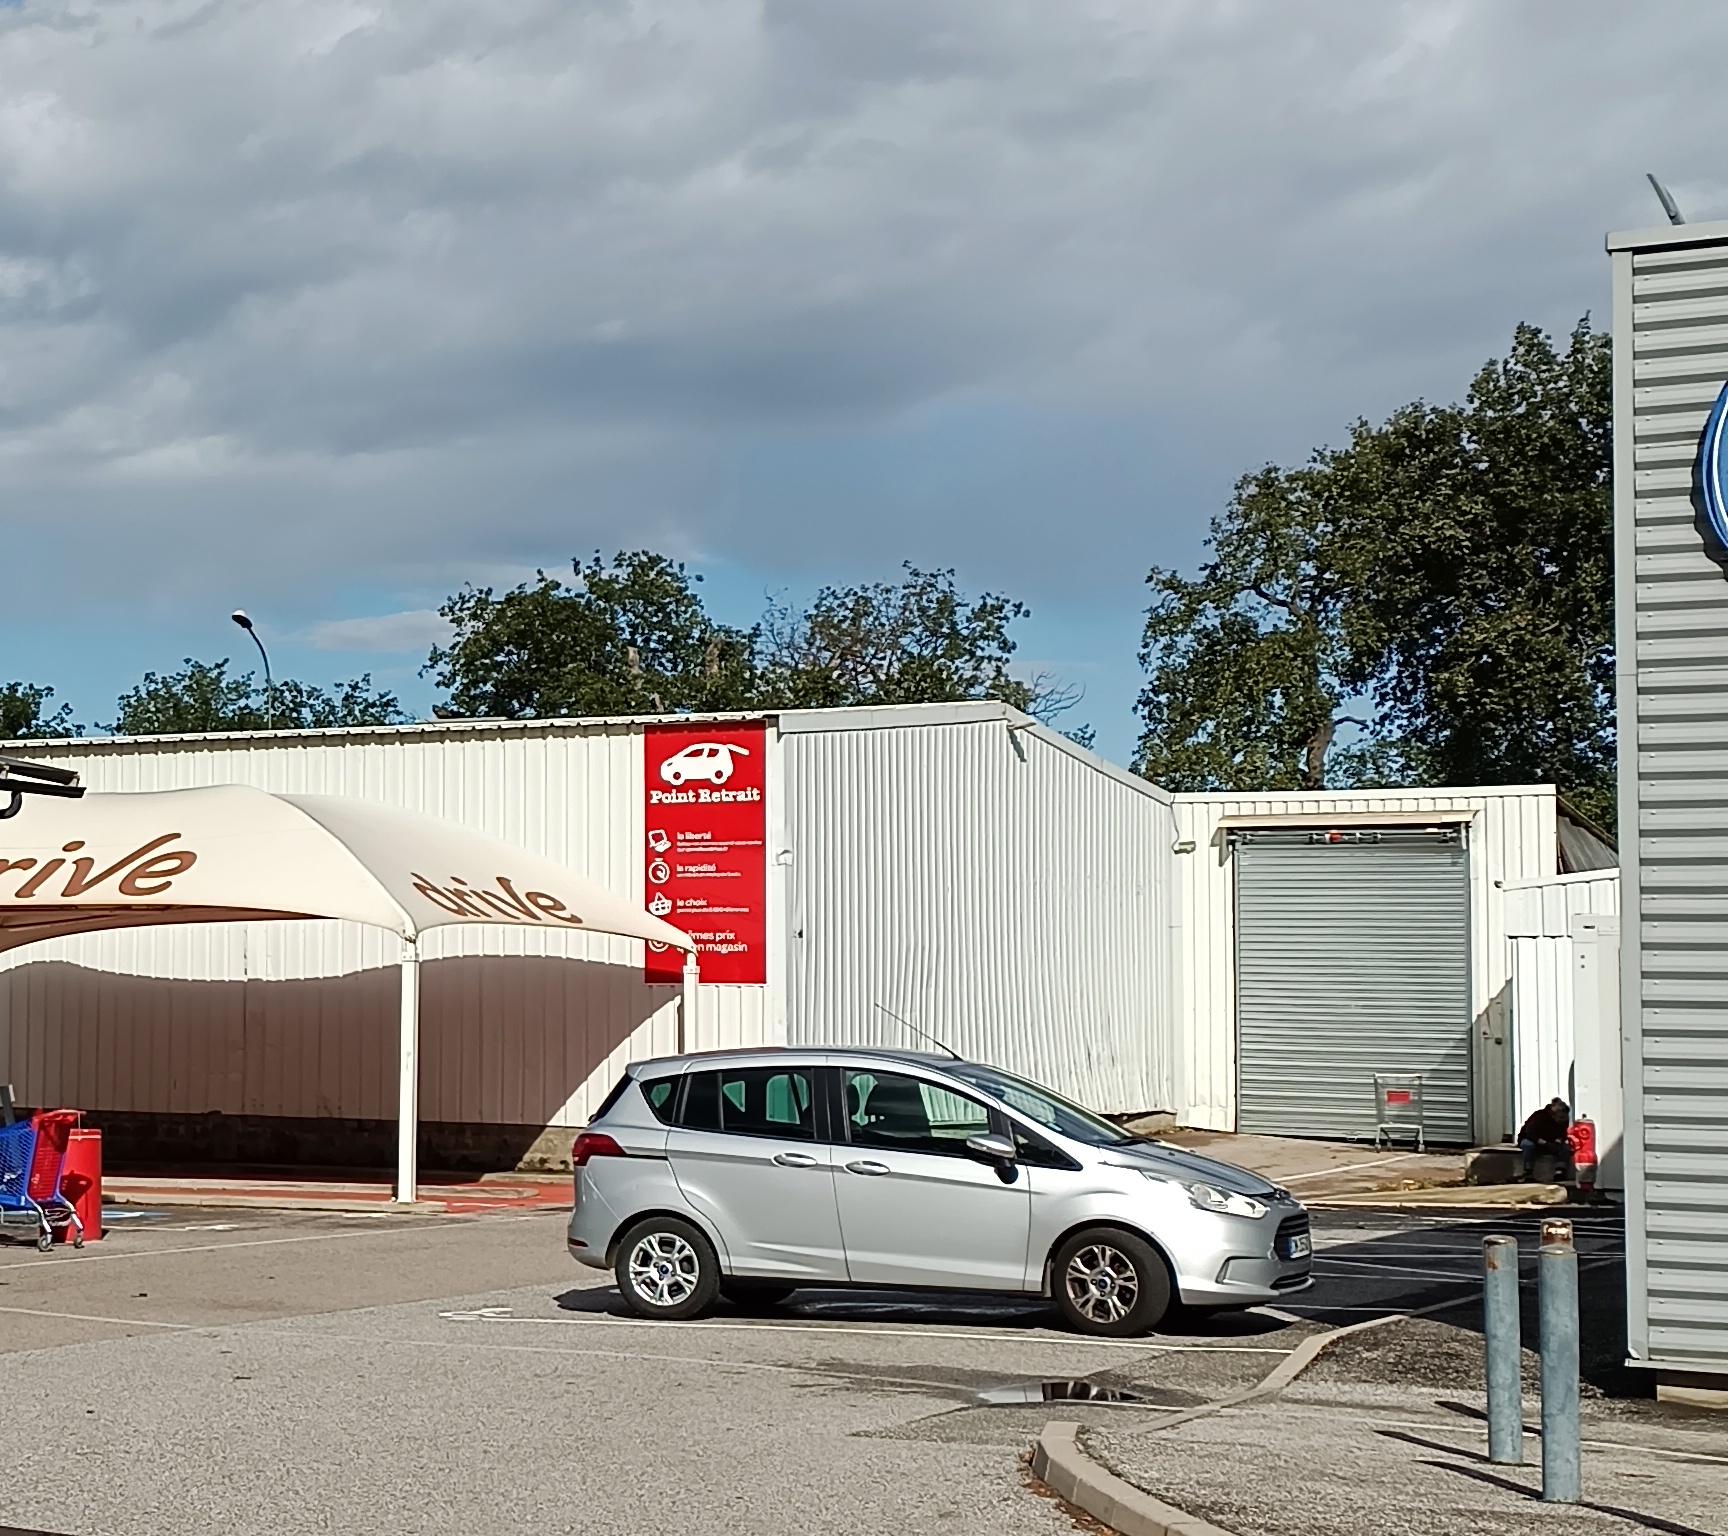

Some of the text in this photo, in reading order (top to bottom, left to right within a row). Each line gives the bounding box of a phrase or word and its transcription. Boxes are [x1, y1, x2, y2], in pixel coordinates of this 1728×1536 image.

[649, 786, 761, 804] Point Retrait
[684, 862, 717, 873] rapidité
[409, 871, 584, 924] drive
[685, 897, 708, 907] choix
[715, 929, 736, 942] prix
[705, 941, 749, 955] magasin
